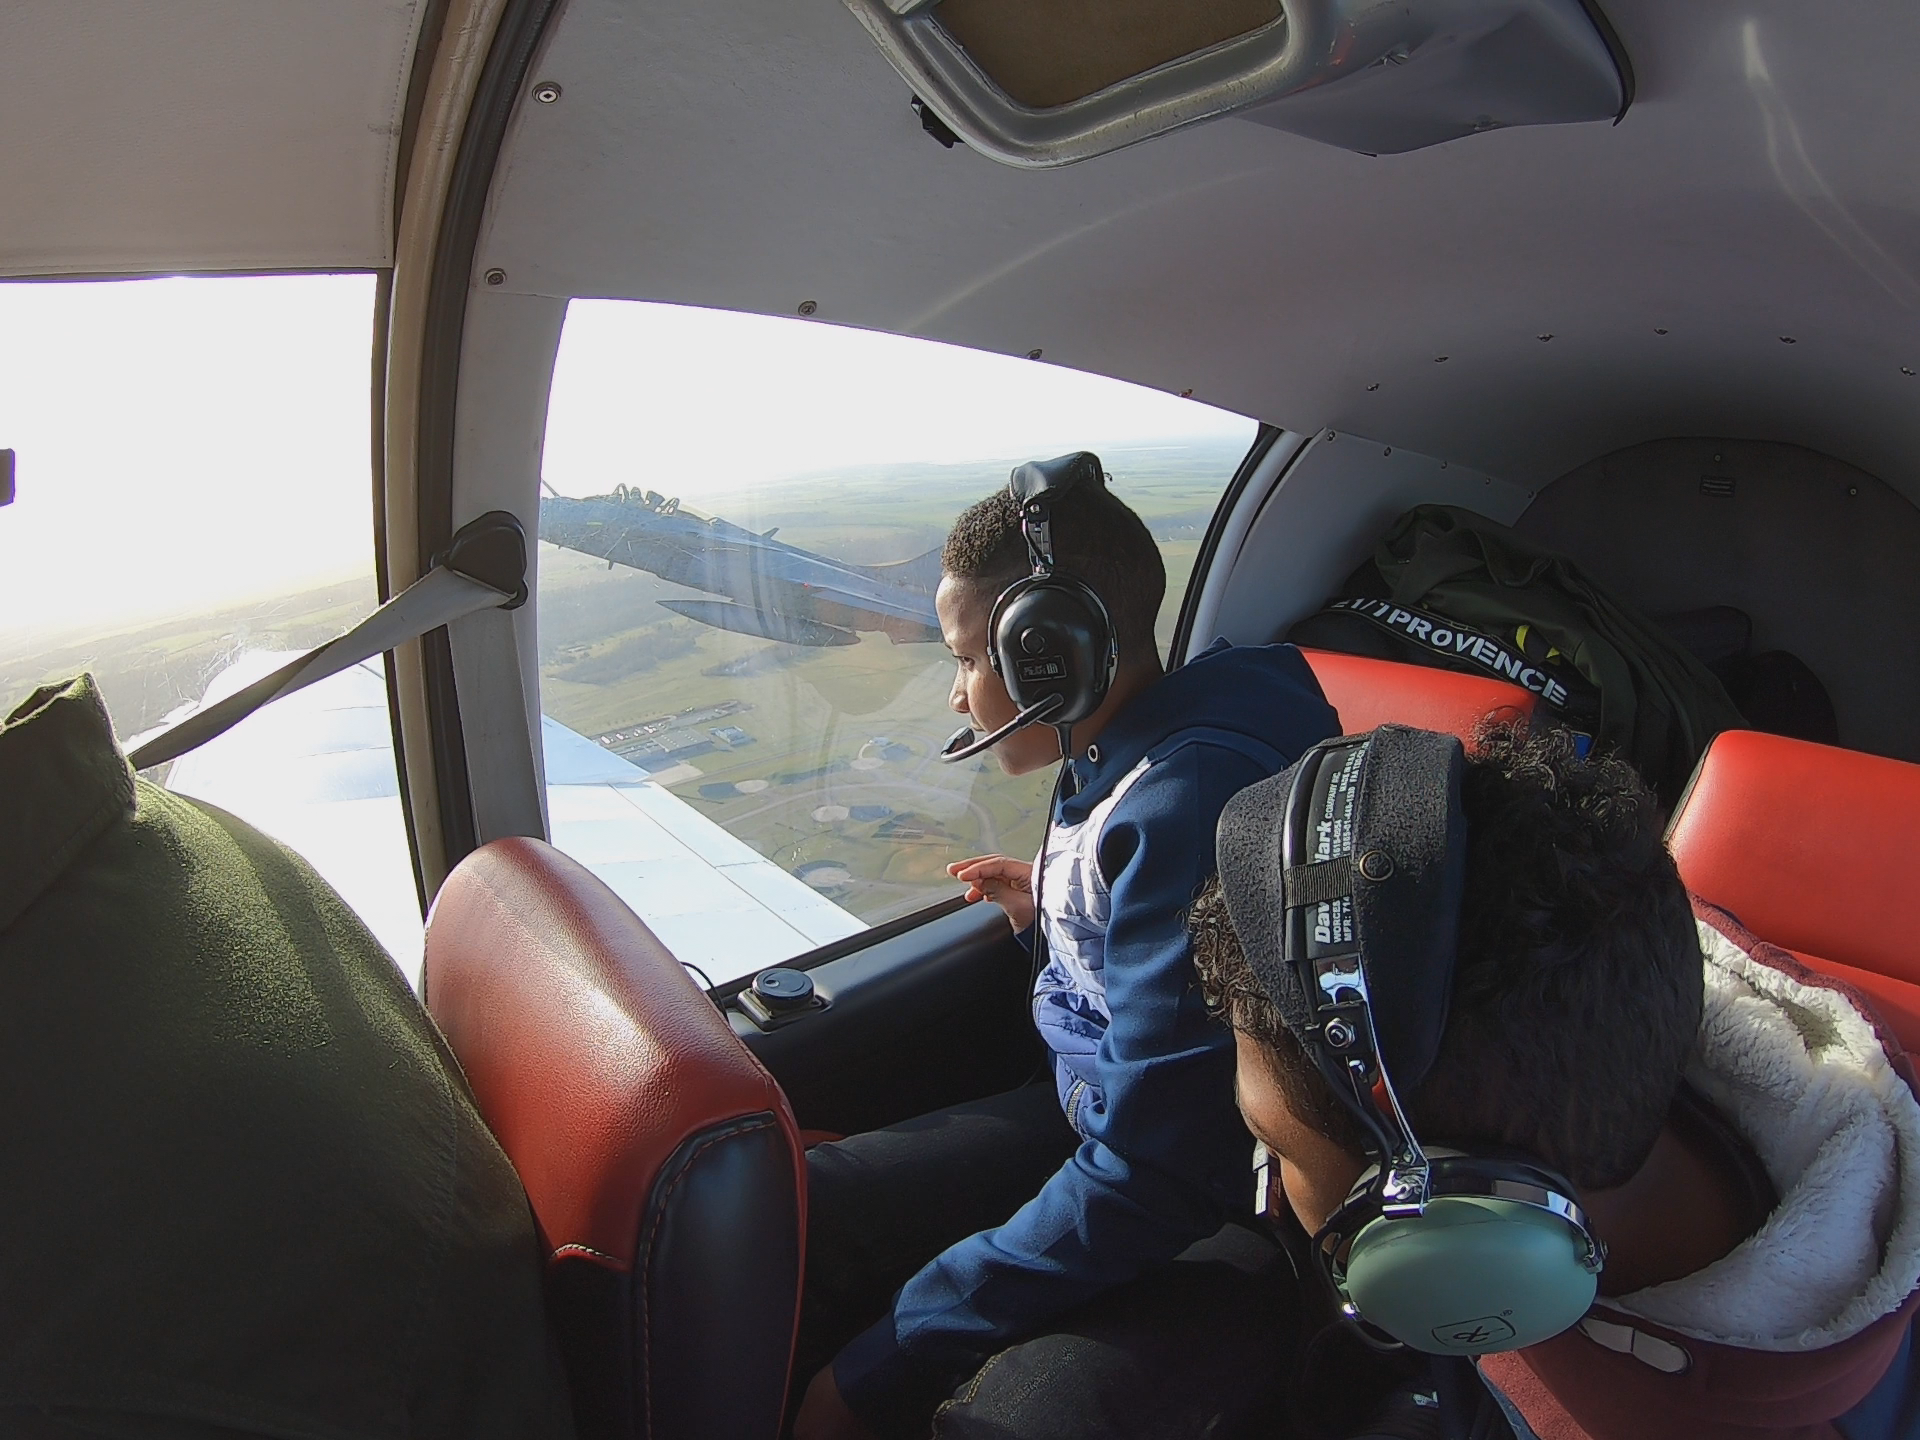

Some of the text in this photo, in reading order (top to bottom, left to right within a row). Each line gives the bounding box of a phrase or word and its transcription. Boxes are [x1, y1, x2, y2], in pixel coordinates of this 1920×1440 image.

[1387, 609, 1568, 706] PROVENCE
[1325, 784, 1338, 819] COMPANY
[1314, 820, 1332, 863] lark
[1314, 901, 1331, 944] Dav
[1333, 900, 1342, 943] WORCES
[1342, 896, 1352, 914] 714
